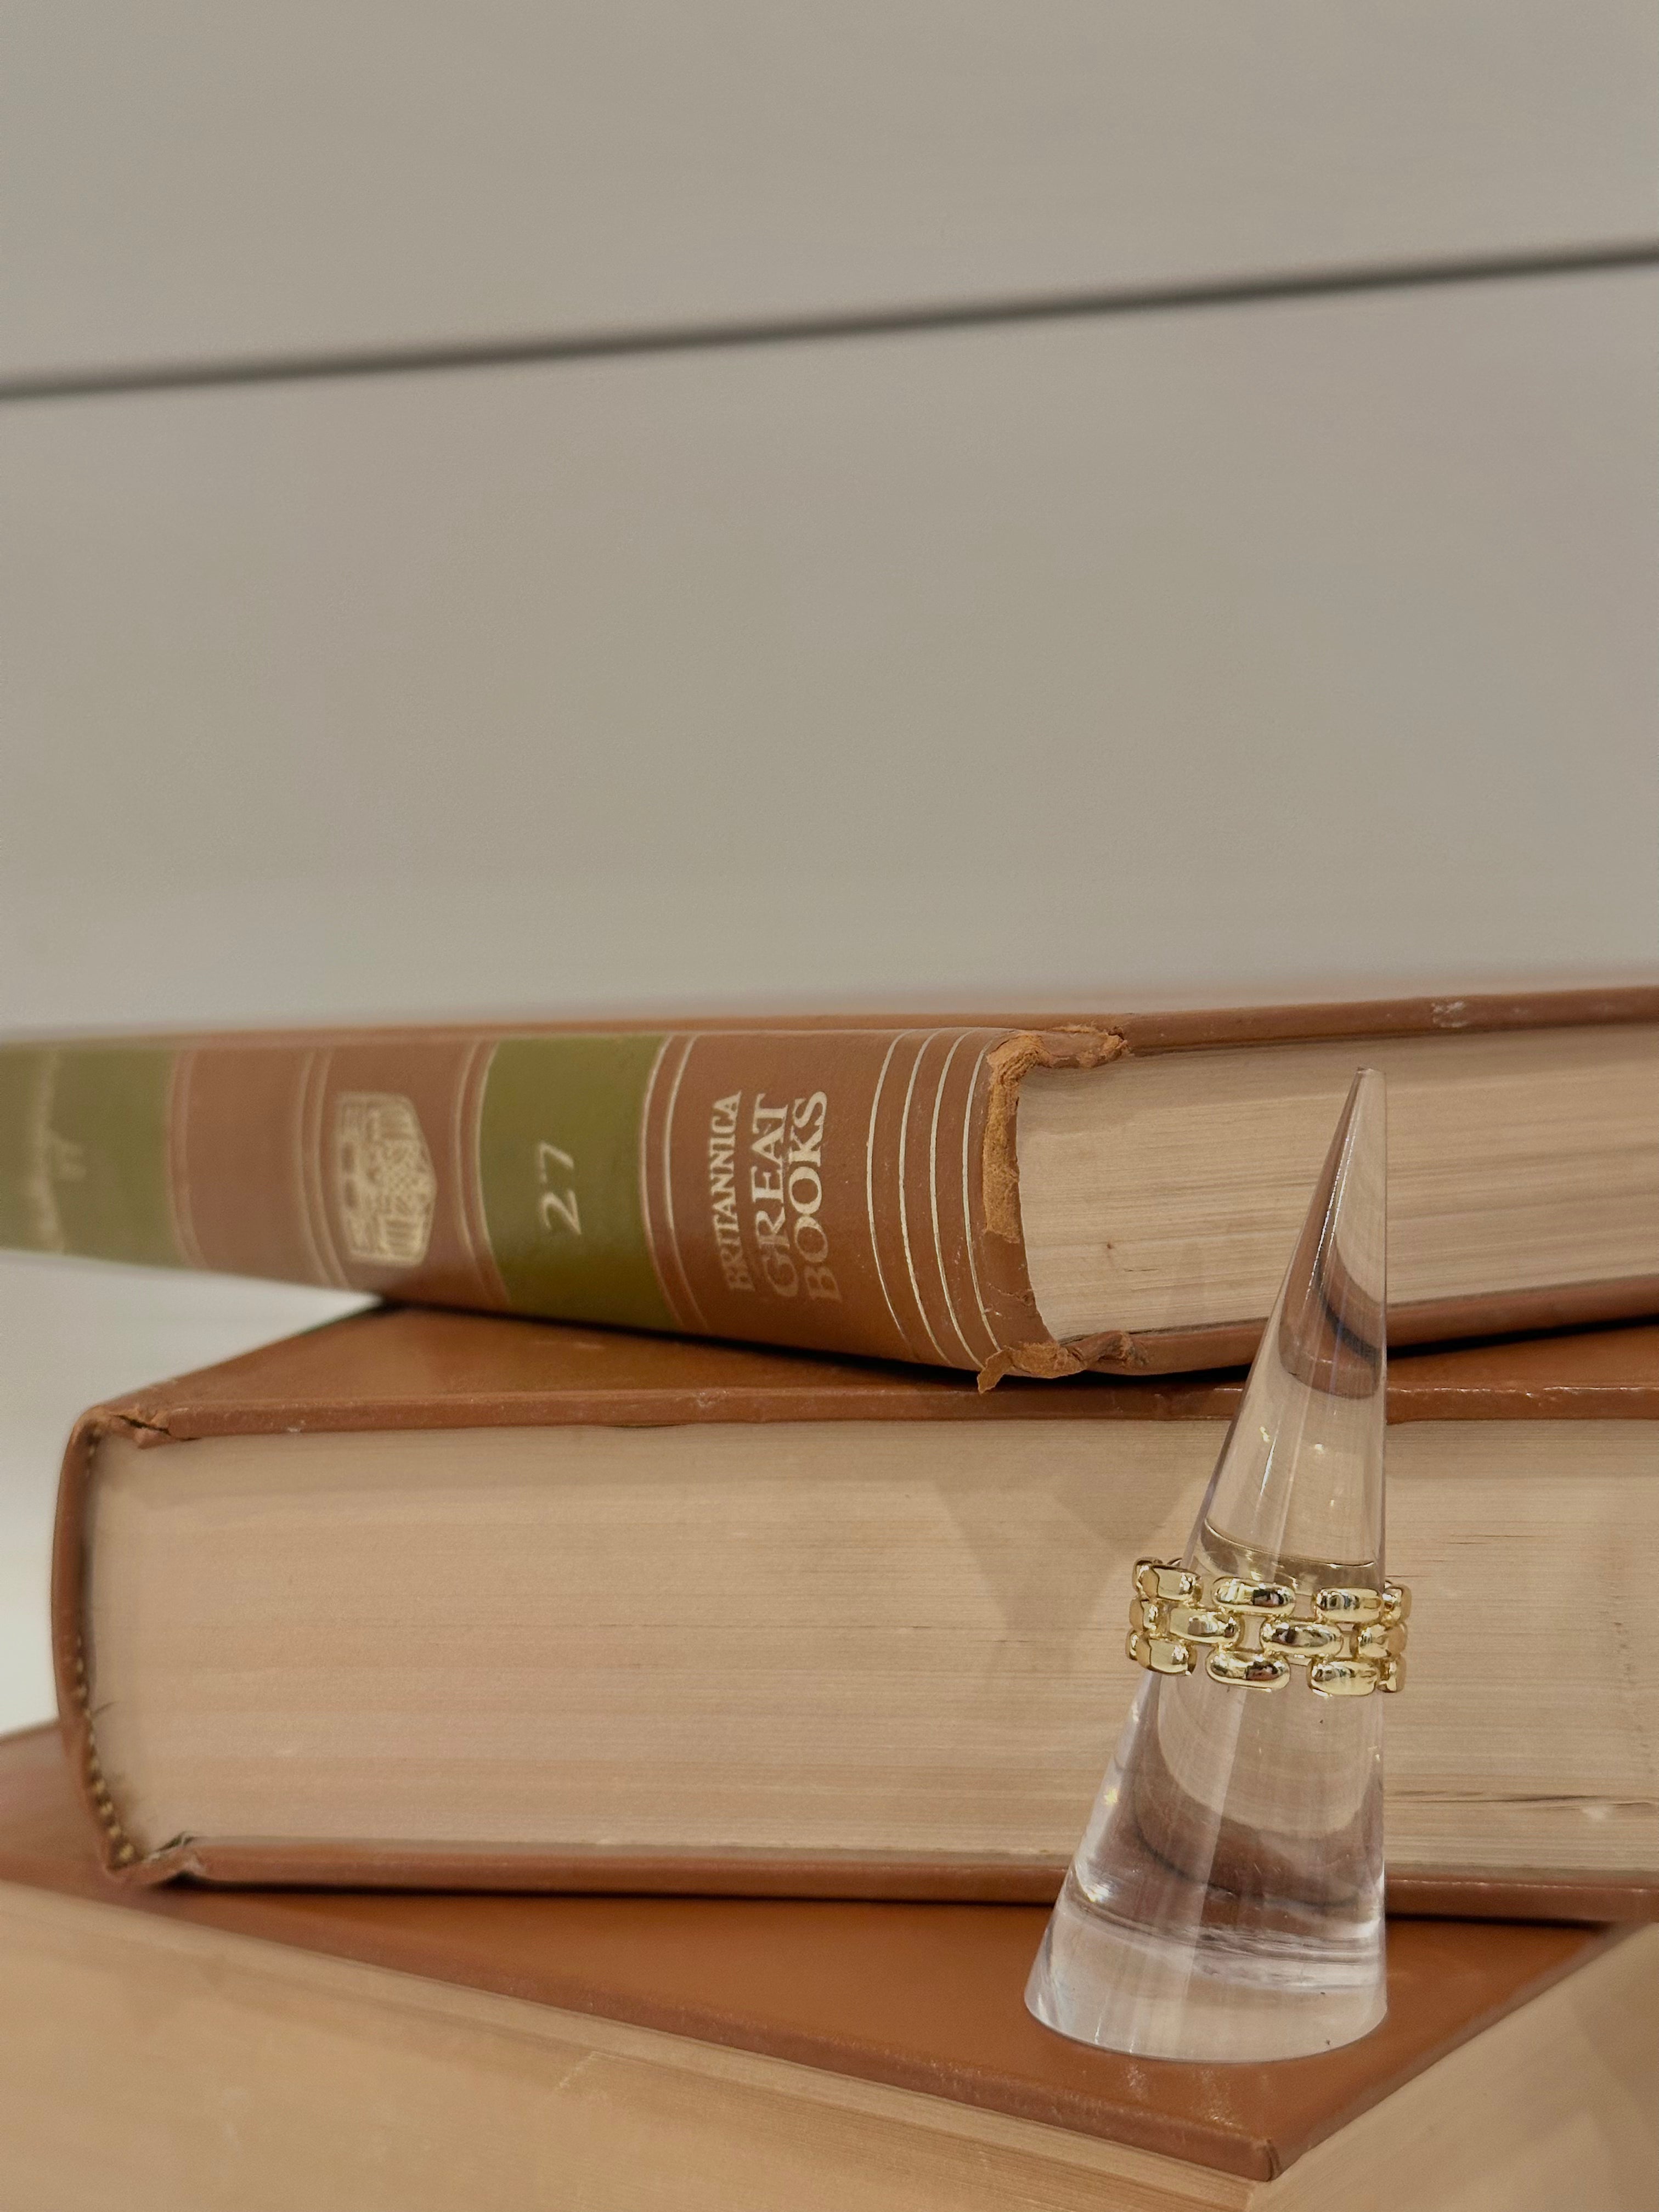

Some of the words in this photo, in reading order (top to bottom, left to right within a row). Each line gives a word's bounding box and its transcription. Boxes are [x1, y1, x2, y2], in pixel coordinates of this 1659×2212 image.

[538, 1142, 582, 1235] 27
[709, 1090, 755, 1292] BRITANNICA
[751, 1092, 799, 1298] GREAT
[788, 1091, 842, 1303] BOOKS
